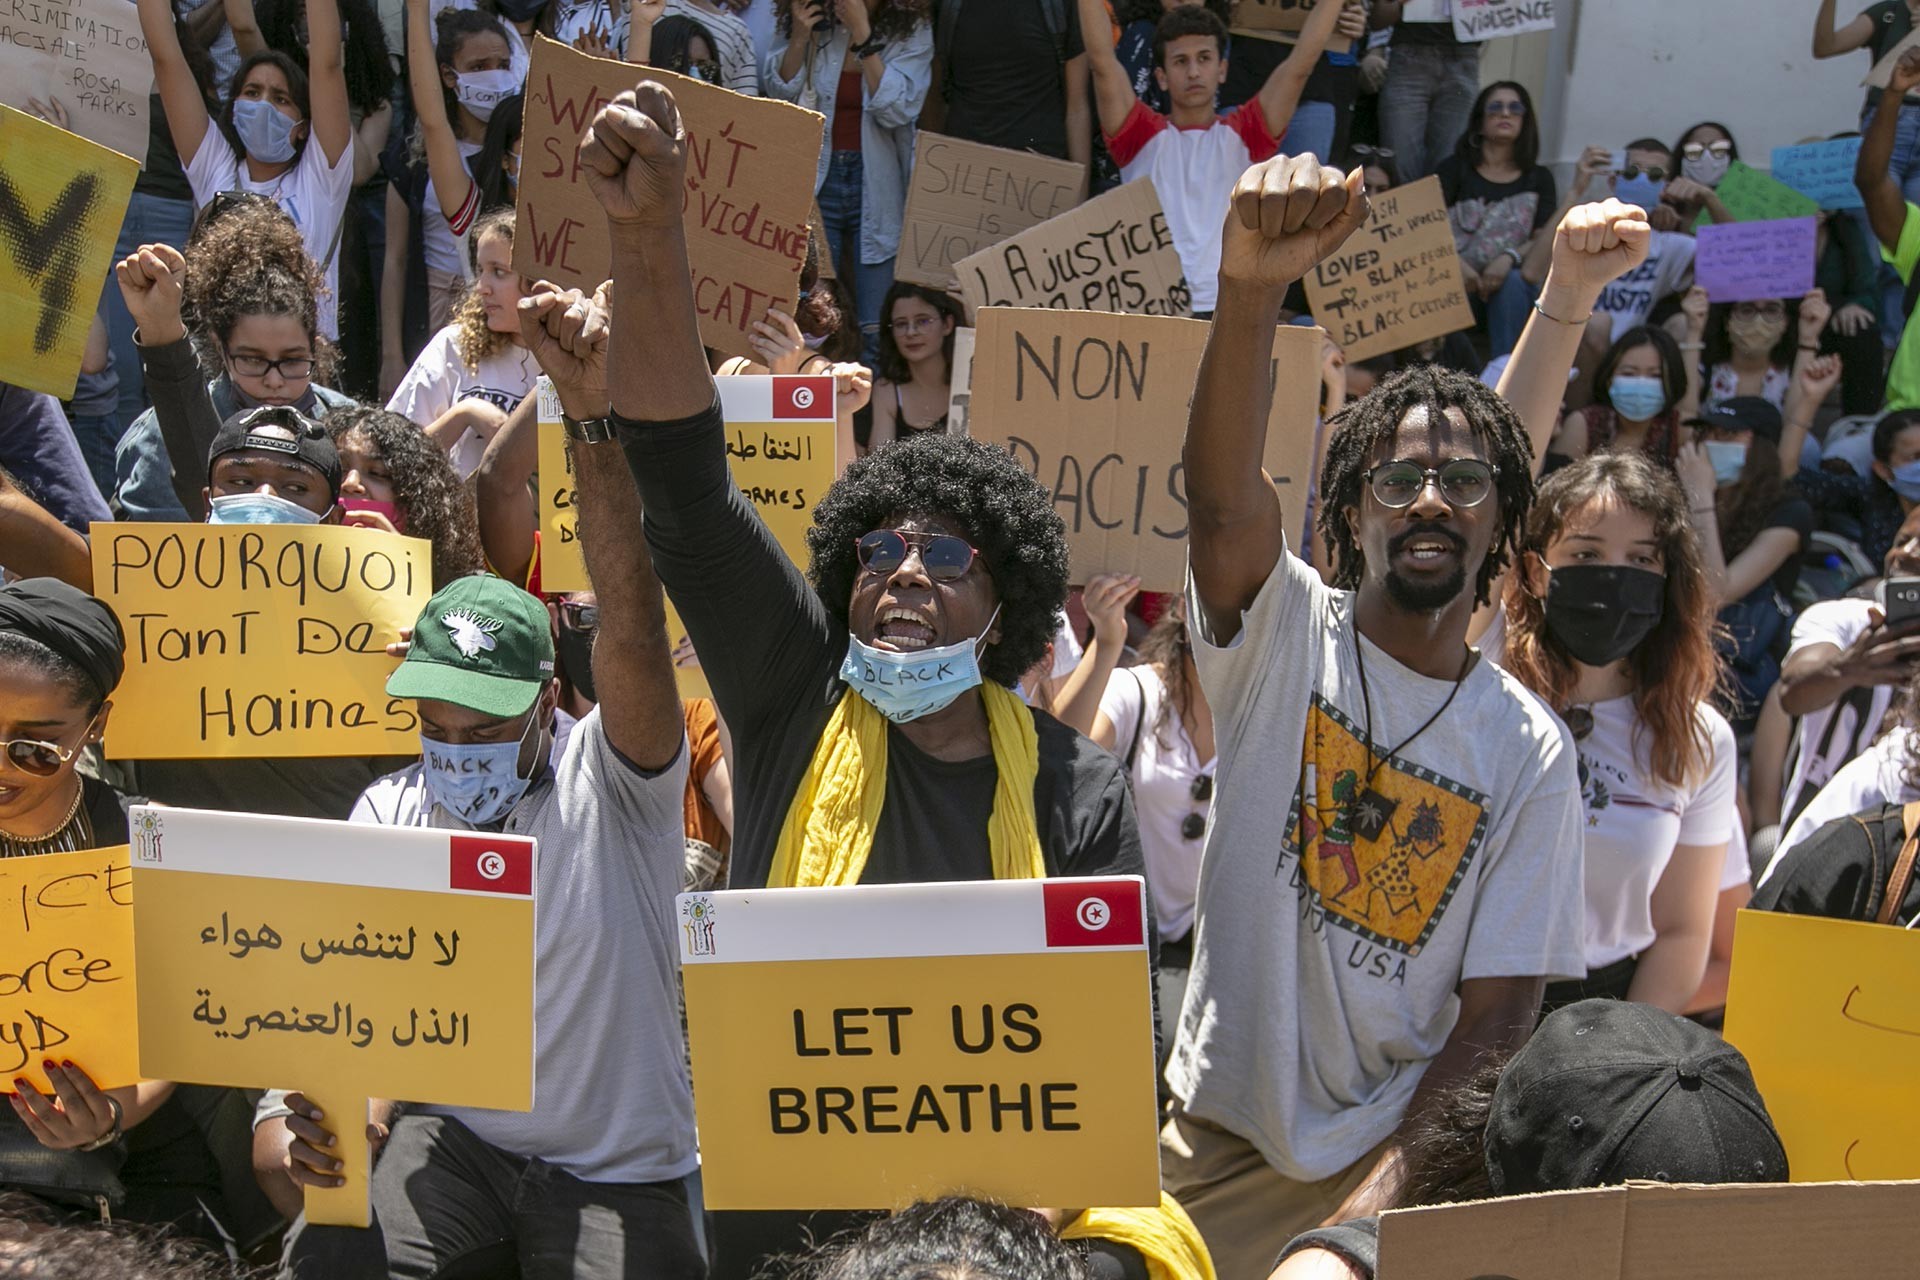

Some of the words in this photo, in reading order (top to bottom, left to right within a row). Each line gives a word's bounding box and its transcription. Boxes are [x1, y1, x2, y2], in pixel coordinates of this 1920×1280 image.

[77, 92, 136, 116] PARKS
[921, 144, 1072, 219] SILENCE
[527, 203, 585, 275] WE
[976, 213, 1001, 234] IS
[1315, 250, 1380, 288] LOVED
[1367, 259, 1416, 287] BLACK
[1341, 307, 1403, 347] BLACK
[1014, 330, 1149, 401] NON
[863, 662, 954, 686] BLACK
[430, 751, 494, 774] BLACK
[200, 911, 283, 959] هواء
[301, 926, 417, 965] لتنفس
[433, 929, 460, 967] لا
[1347, 939, 1407, 986] USA
[193, 988, 374, 1049] والعنصرية
[392, 1004, 470, 1048] الذل
[793, 1007, 913, 1057] LET
[951, 1002, 1042, 1054] US
[769, 1083, 1081, 1134] BREATHE
